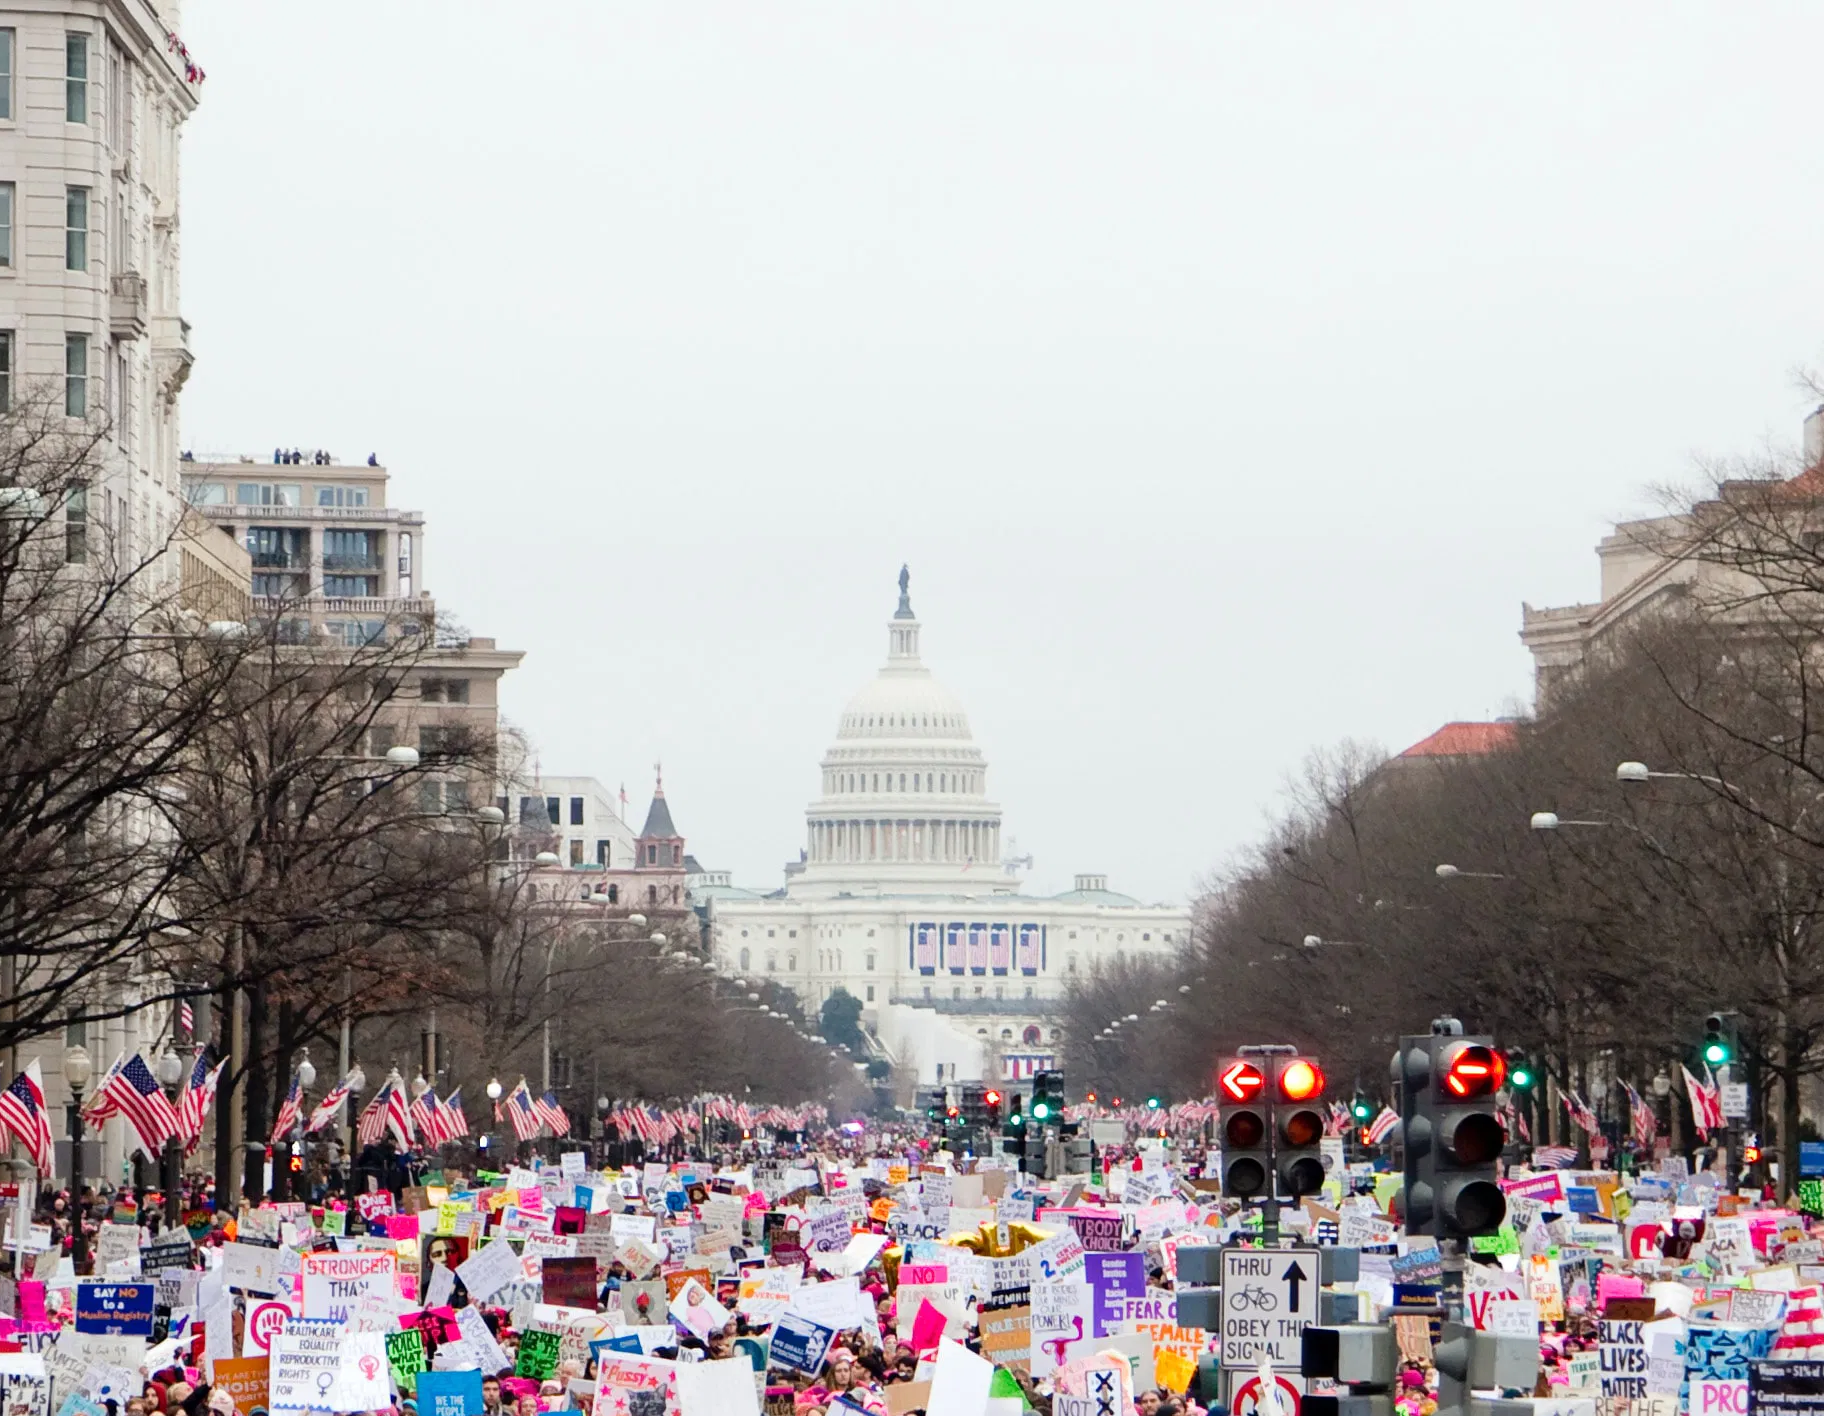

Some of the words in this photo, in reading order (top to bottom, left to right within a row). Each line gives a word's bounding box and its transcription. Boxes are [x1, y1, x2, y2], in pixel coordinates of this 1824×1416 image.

[1229, 1258, 1271, 1277] THRU
[93, 1288, 115, 1299] SAY
[119, 1288, 138, 1299] NO
[284, 1326, 336, 1339] HEALTHCARE
[1226, 1319, 1270, 1338] OBEY
[1597, 1321, 1644, 1343] BLACK
[298, 1340, 339, 1351] EQUALITY
[1227, 1343, 1284, 1360] SIGNAL
[1599, 1347, 1645, 1372] LIVES
[278, 1368, 310, 1380] RIGHTS
[1601, 1378, 1647, 1399] MATTER
